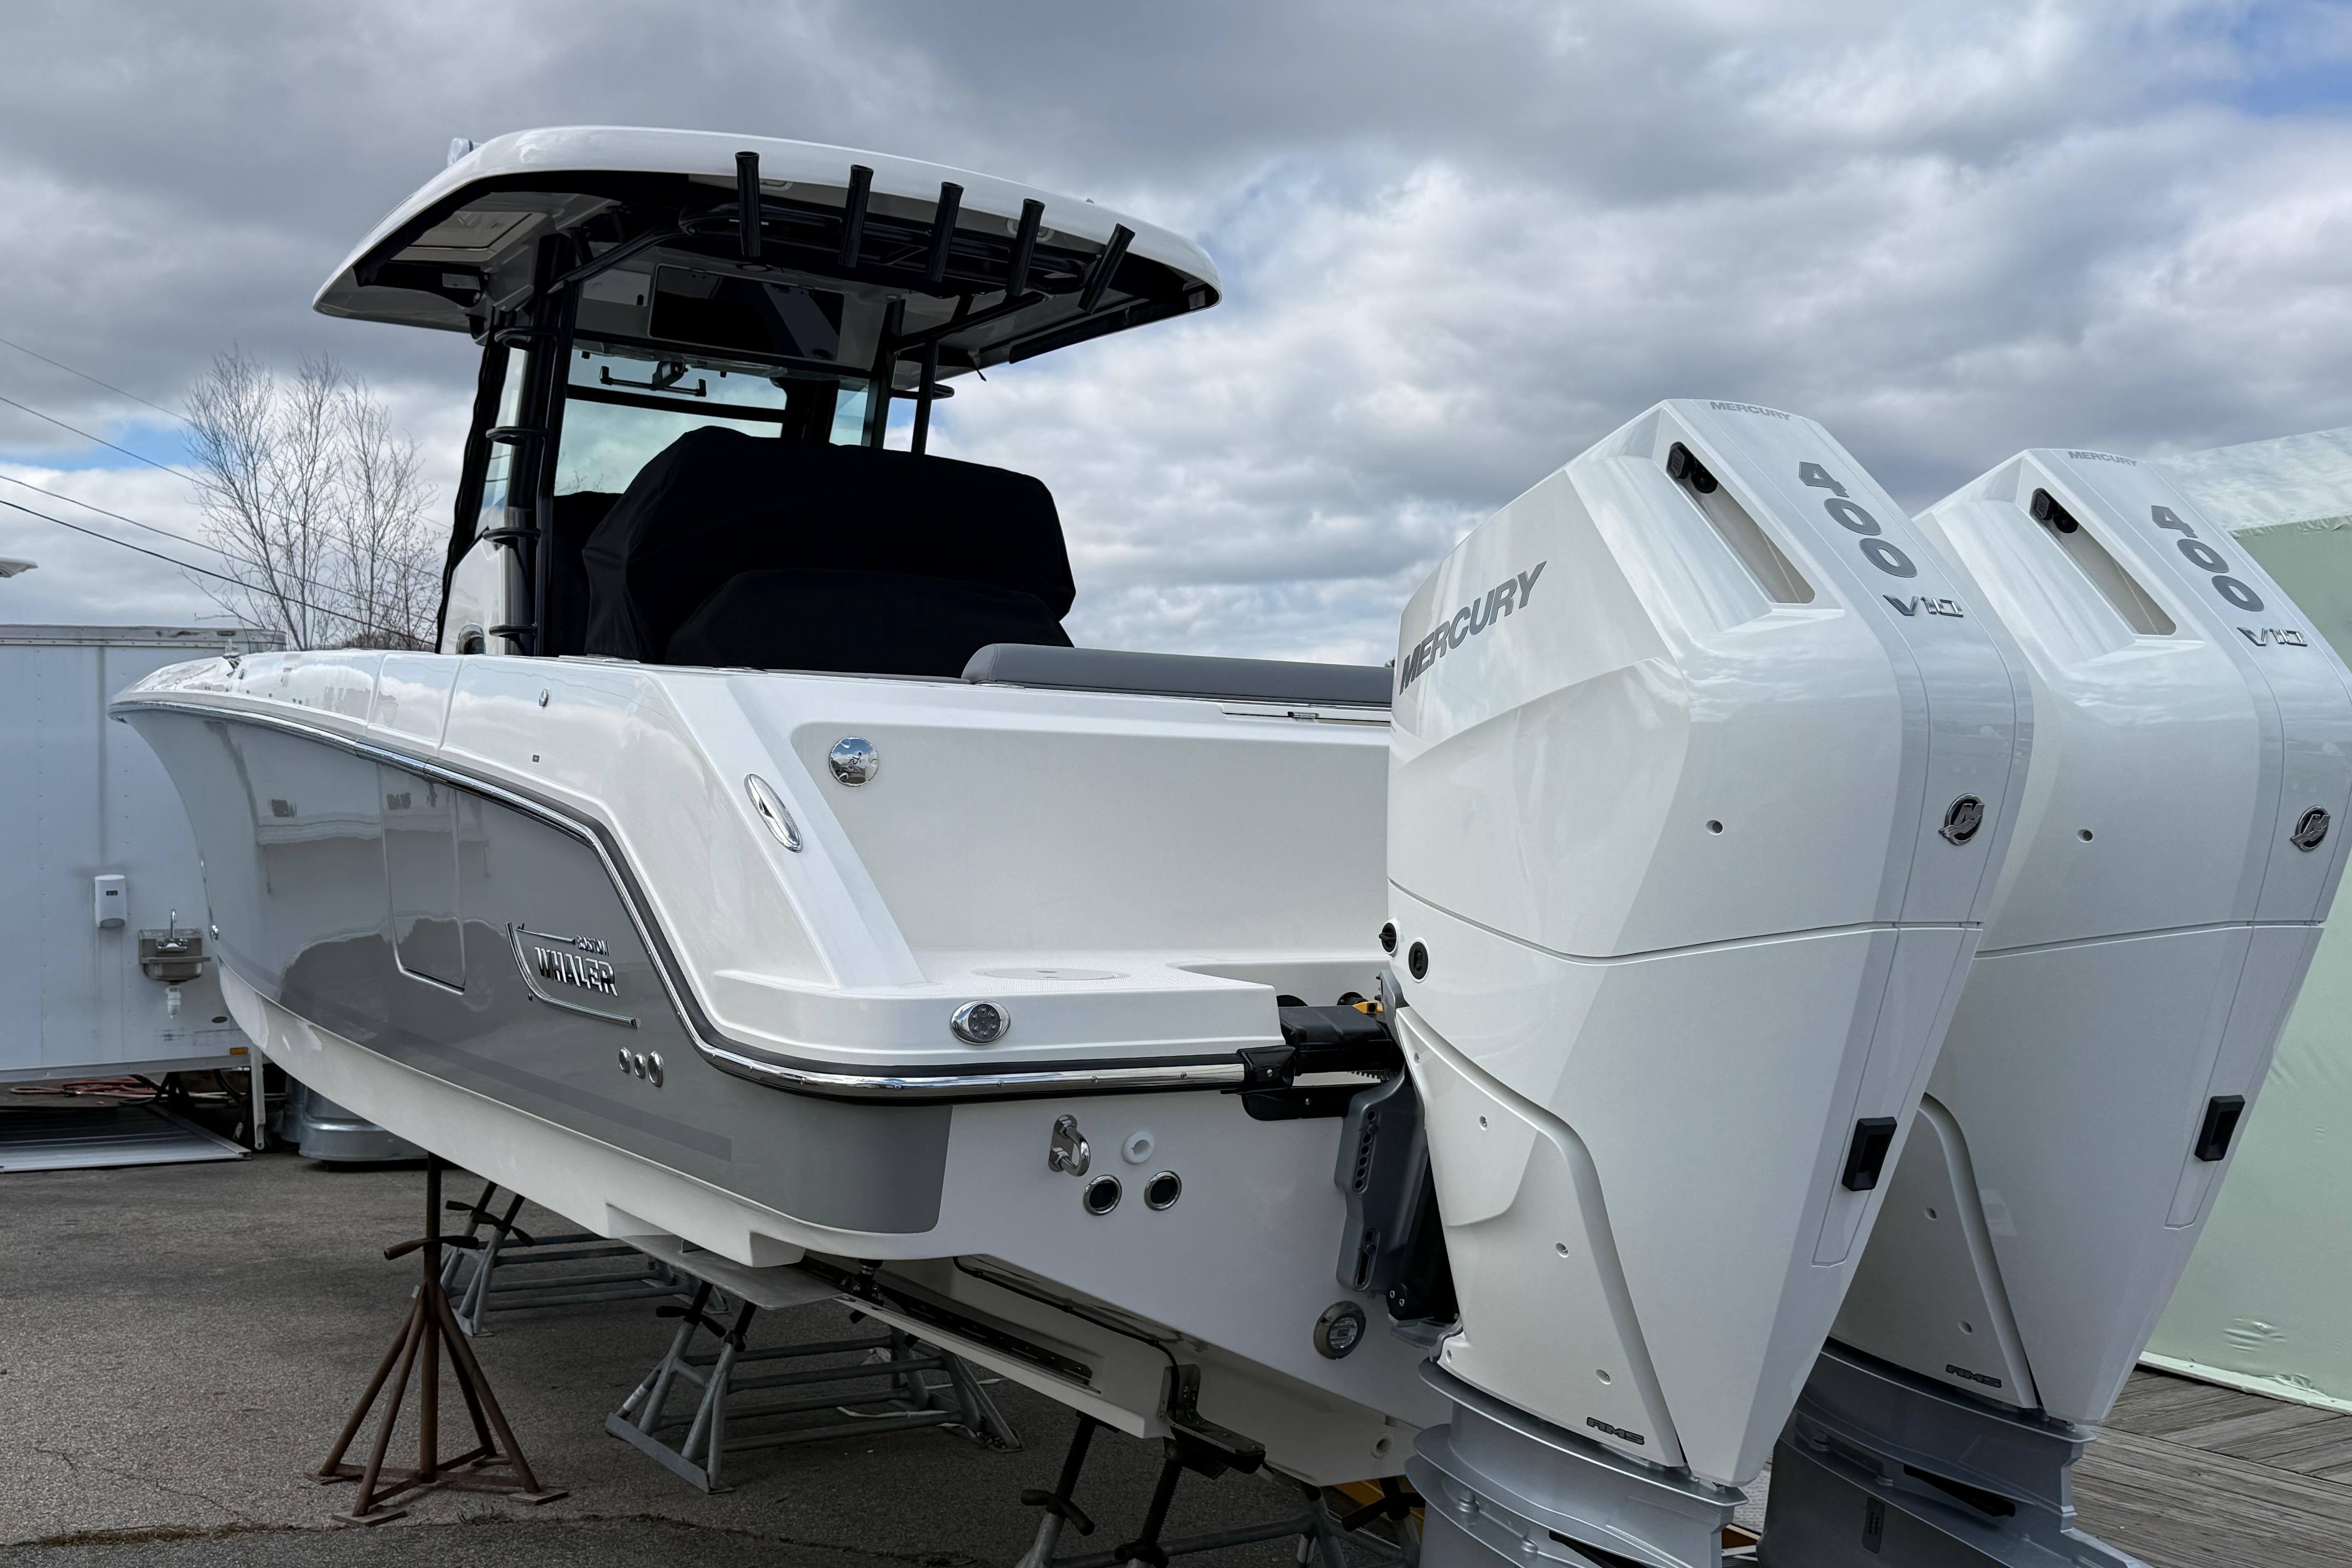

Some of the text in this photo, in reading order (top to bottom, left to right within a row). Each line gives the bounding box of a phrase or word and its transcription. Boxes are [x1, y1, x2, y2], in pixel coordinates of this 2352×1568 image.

[1710, 401, 1791, 420] MERCURY
[2069, 451, 2137, 466] MERCURY
[1799, 461, 1917, 578] 400
[2151, 505, 2264, 611] 400
[1883, 595, 1964, 616] V10
[1399, 560, 1547, 695] MERCURY
[2237, 627, 2308, 646] V10
[534, 947, 619, 996] WHALER
[1587, 1417, 1645, 1445] AMS
